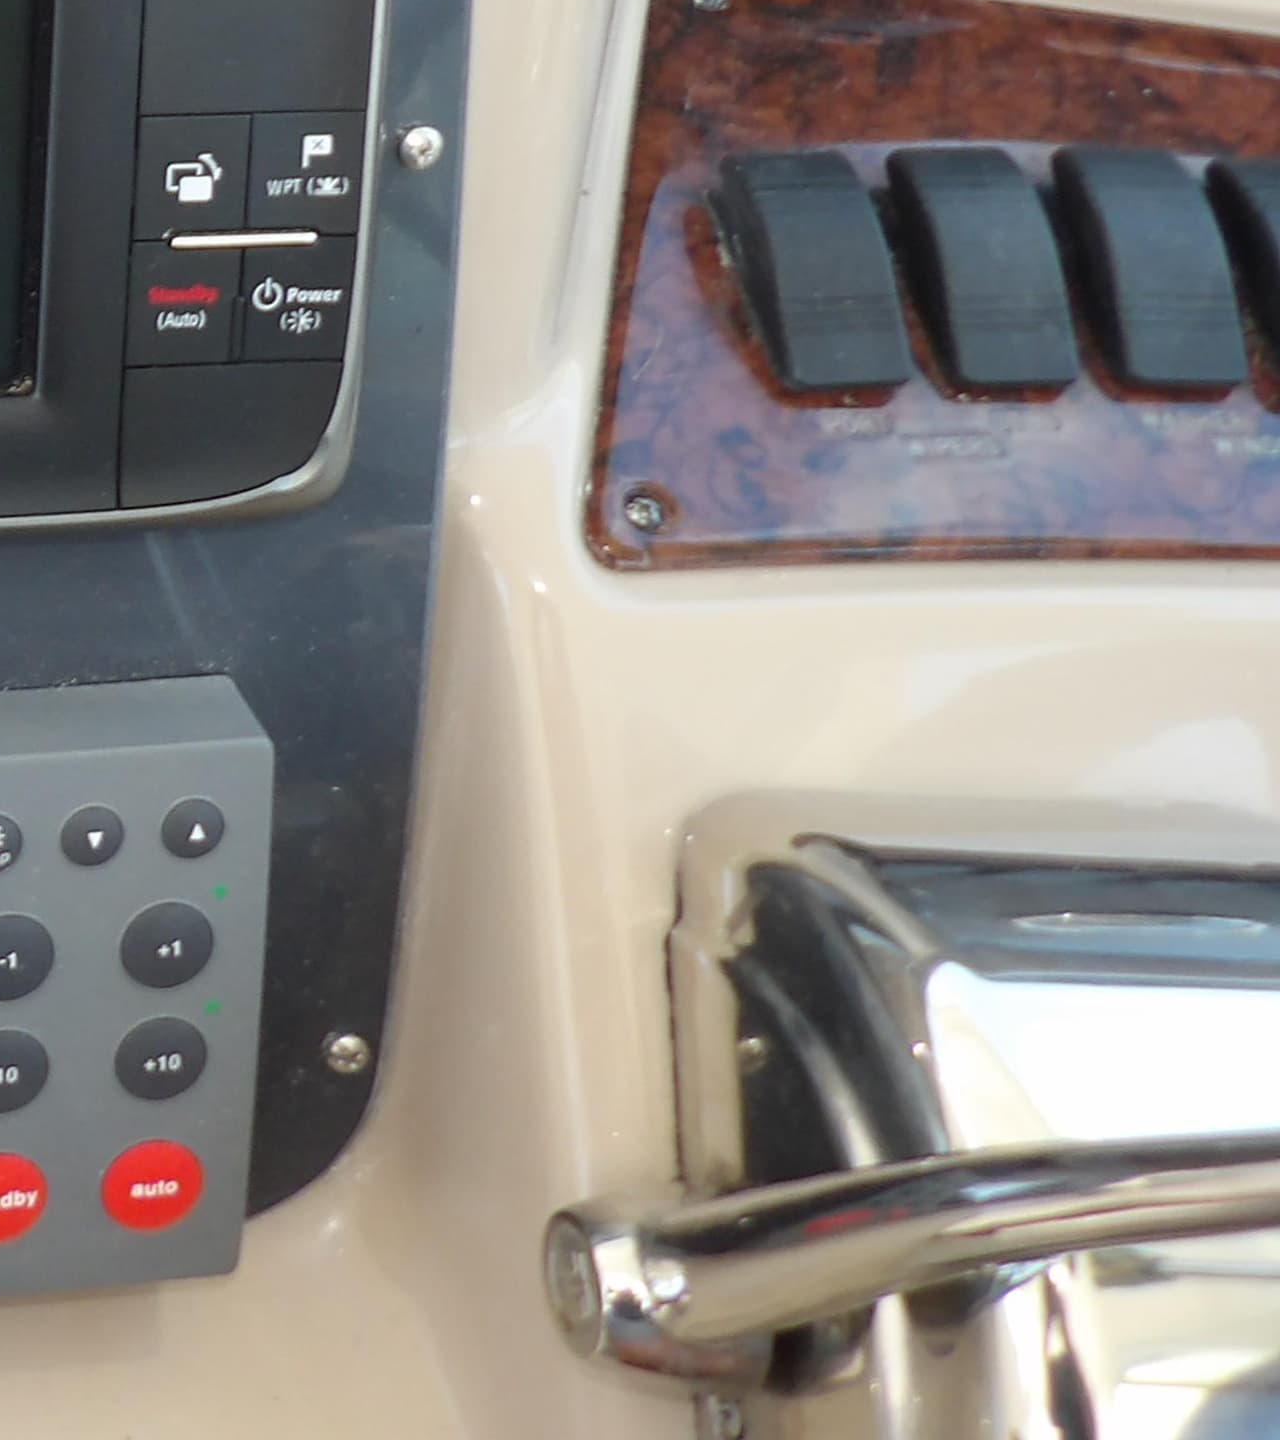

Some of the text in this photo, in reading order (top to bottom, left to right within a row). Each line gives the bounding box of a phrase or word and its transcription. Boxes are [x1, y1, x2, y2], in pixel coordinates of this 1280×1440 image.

[267, 178, 303, 196] WPT
[286, 287, 342, 304] Power
[157, 309, 206, 330] (Auto)
[157, 939, 182, 958] +1
[143, 1053, 182, 1072] +10
[130, 1179, 179, 1199] auto
